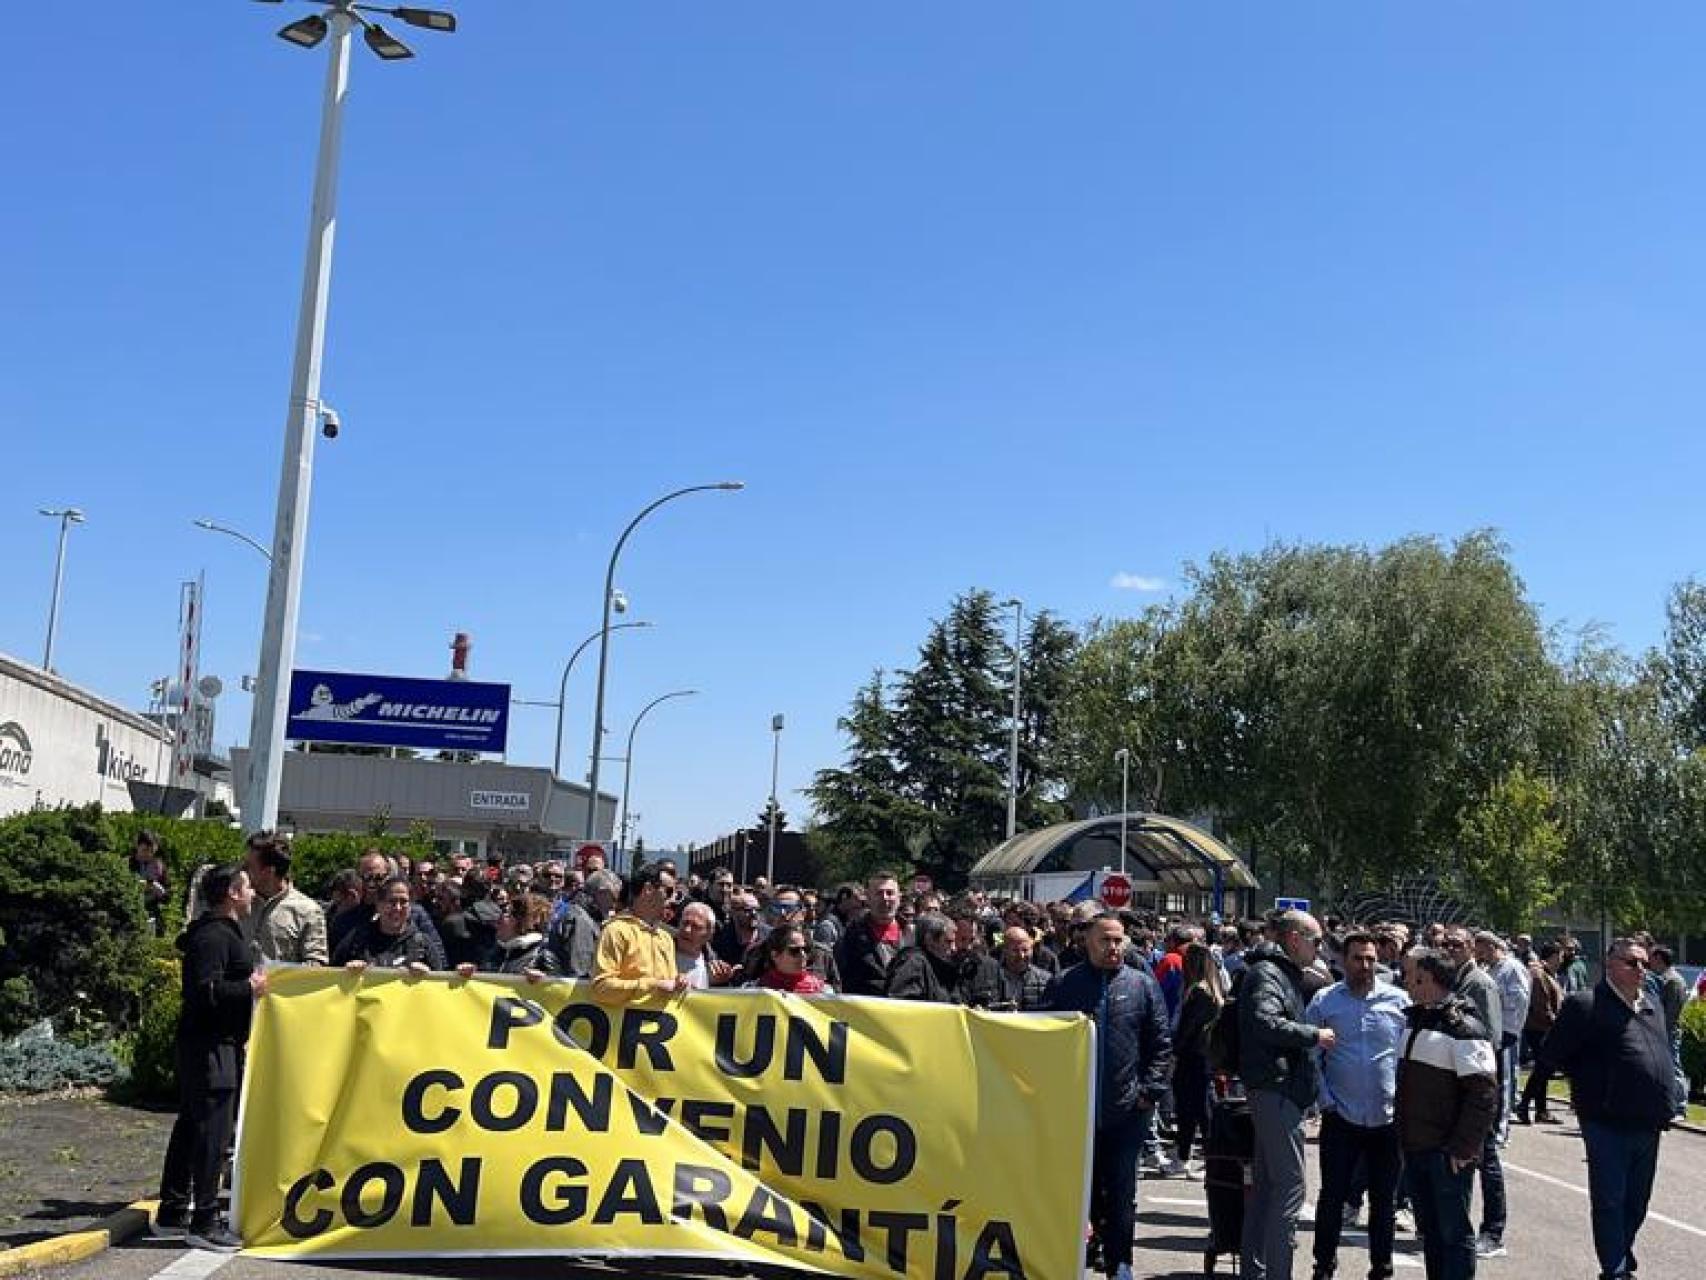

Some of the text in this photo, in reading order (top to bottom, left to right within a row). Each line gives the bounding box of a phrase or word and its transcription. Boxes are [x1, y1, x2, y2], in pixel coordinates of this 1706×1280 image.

[378, 702, 500, 723] MICHELIN
[109, 746, 148, 783] kider
[472, 792, 526, 806] ENTRADA
[488, 996, 849, 1085] POR UN
[401, 1070, 917, 1185] CONVENIO
[281, 1155, 1027, 1280] CON GARANTÍA
